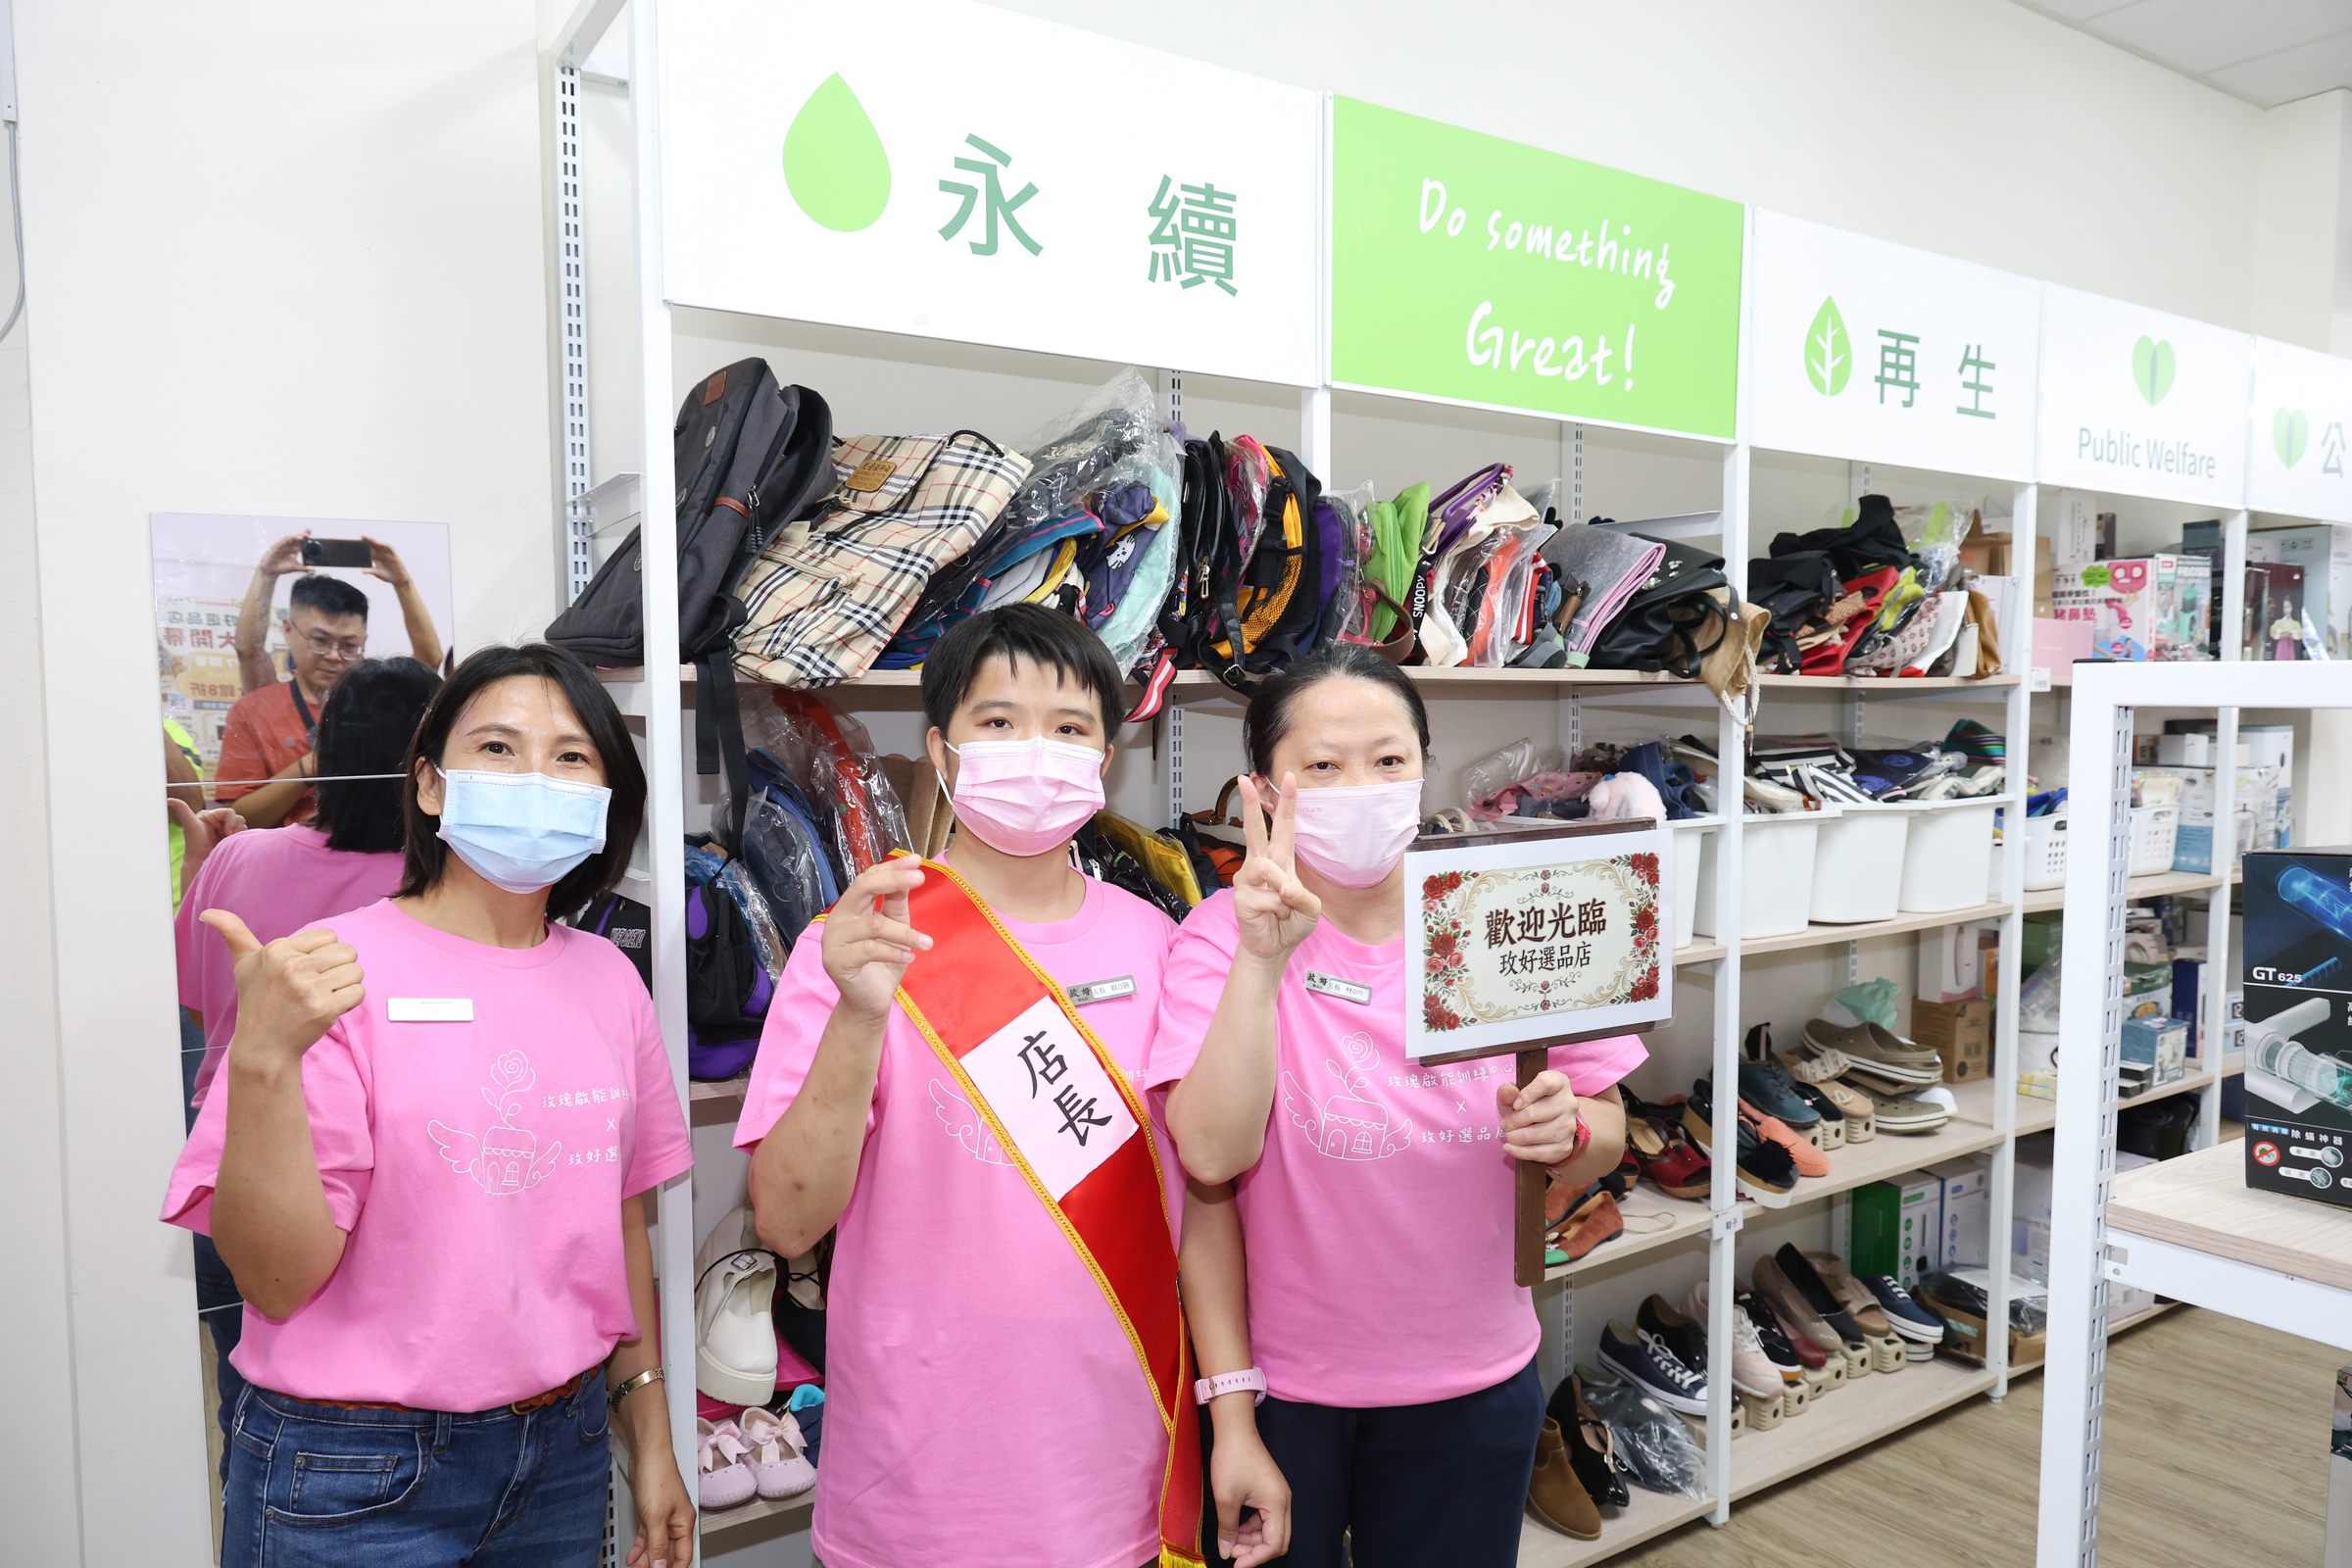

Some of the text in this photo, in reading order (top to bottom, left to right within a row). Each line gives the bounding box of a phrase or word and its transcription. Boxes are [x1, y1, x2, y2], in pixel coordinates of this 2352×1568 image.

[1419, 176, 1677, 311] Do something
[1465, 300, 1636, 392] Great!
[1874, 328, 1996, 420] 再生
[2079, 427, 2217, 479] Public Welfare
[2321, 421, 2348, 479] 公
[1412, 574, 1426, 618] SNOOPY
[1485, 898, 1607, 950] 歡迎光臨
[1498, 941, 1592, 977] 玫好選品店
[2252, 966, 2302, 983] GT 625
[1017, 1030, 1113, 1147] 店長
[1387, 1062, 1515, 1089] 玫瑰啟能訓練中心
